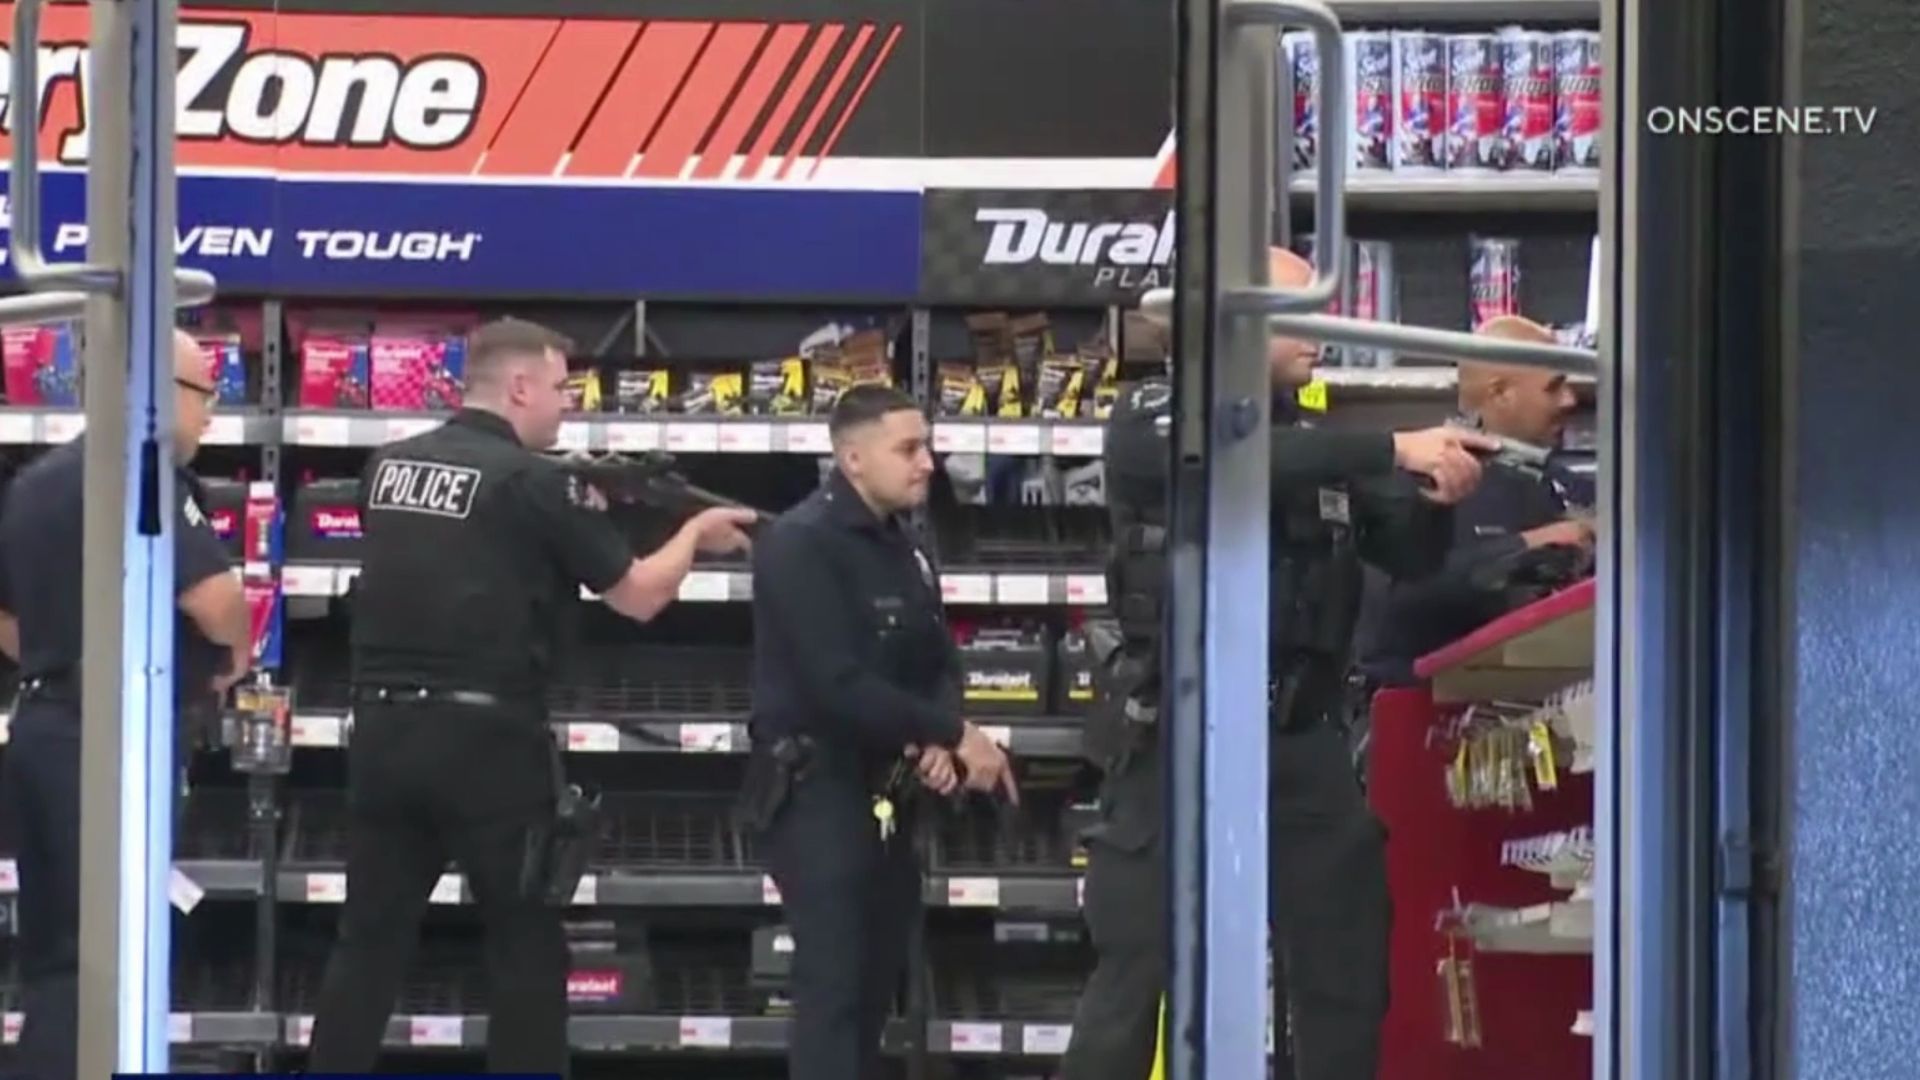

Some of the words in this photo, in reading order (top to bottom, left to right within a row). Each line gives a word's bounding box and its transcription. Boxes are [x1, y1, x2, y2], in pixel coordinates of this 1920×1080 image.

[175, 22, 484, 148] Zone
[54, 223, 273, 256] PVEN
[296, 230, 474, 260] TOUGH
[1094, 267, 1174, 288] PLA
[377, 465, 470, 512] POLICE
